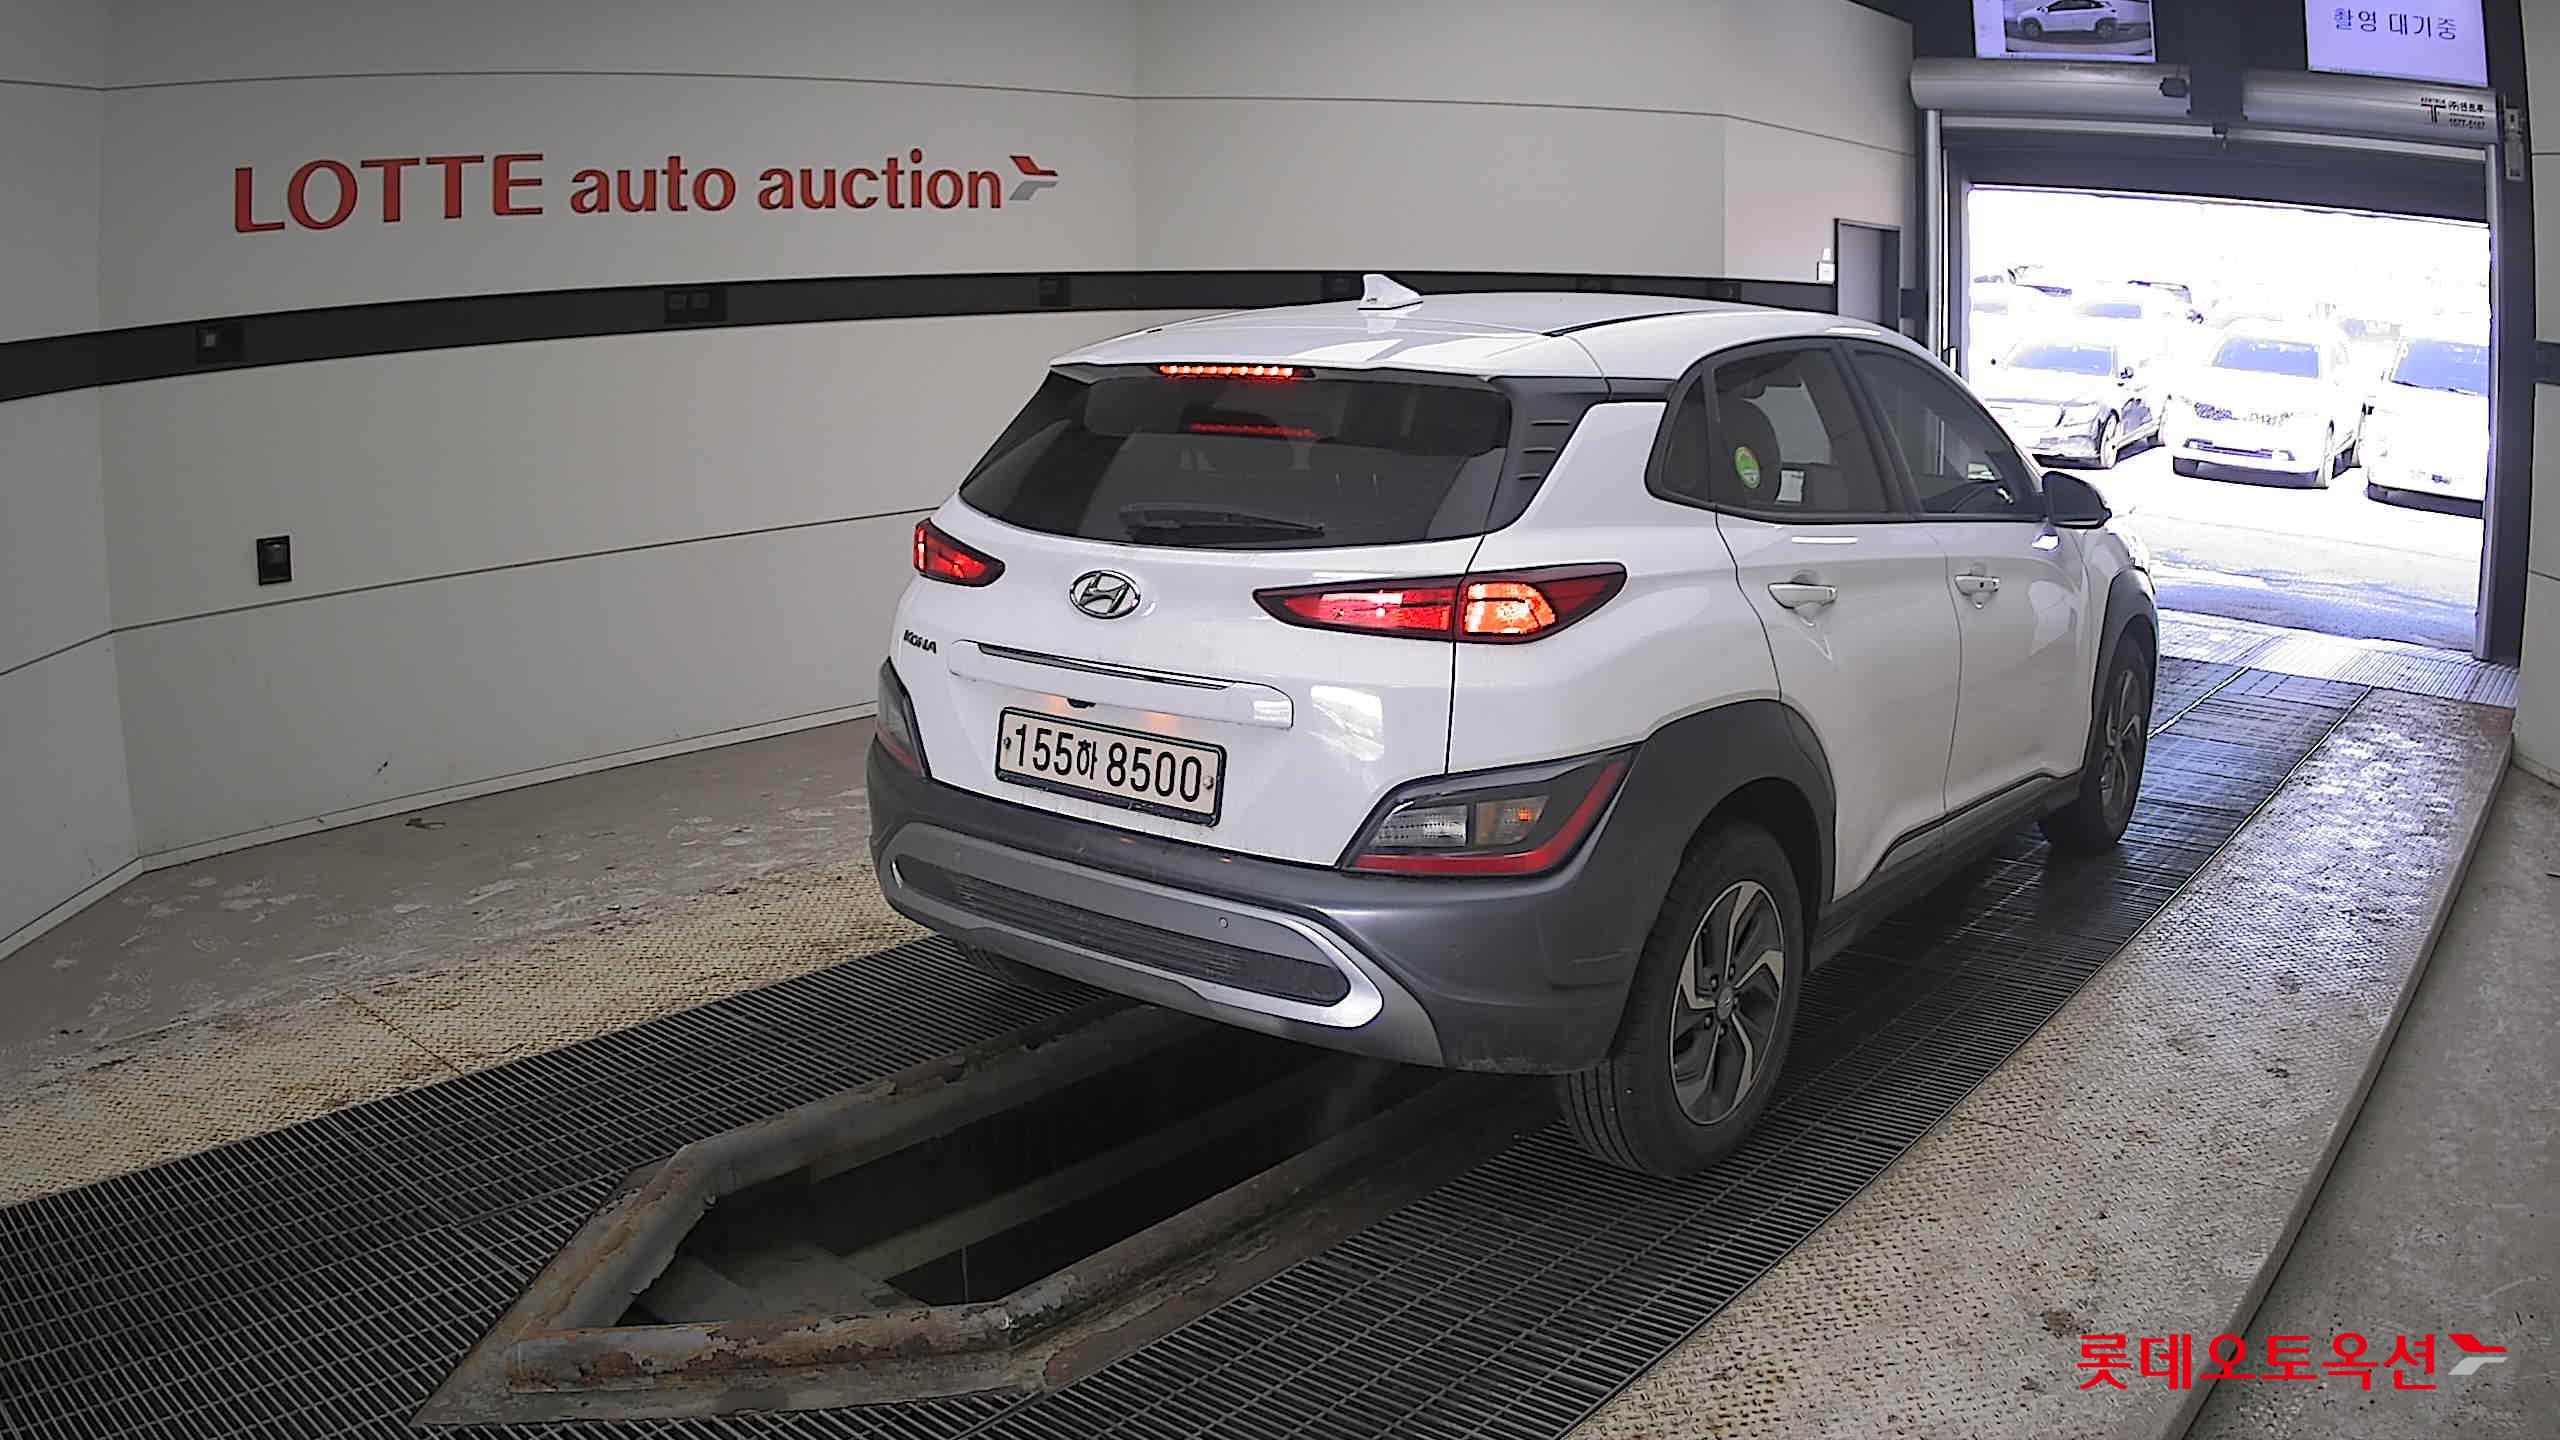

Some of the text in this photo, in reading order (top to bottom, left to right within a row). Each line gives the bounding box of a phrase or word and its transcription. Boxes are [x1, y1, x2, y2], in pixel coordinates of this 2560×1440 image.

[2334, 8, 2457, 40] 촬영 대기중
[234, 147, 1002, 233] LOTTE auto auction
[1015, 723, 1202, 803] 155하 8500
